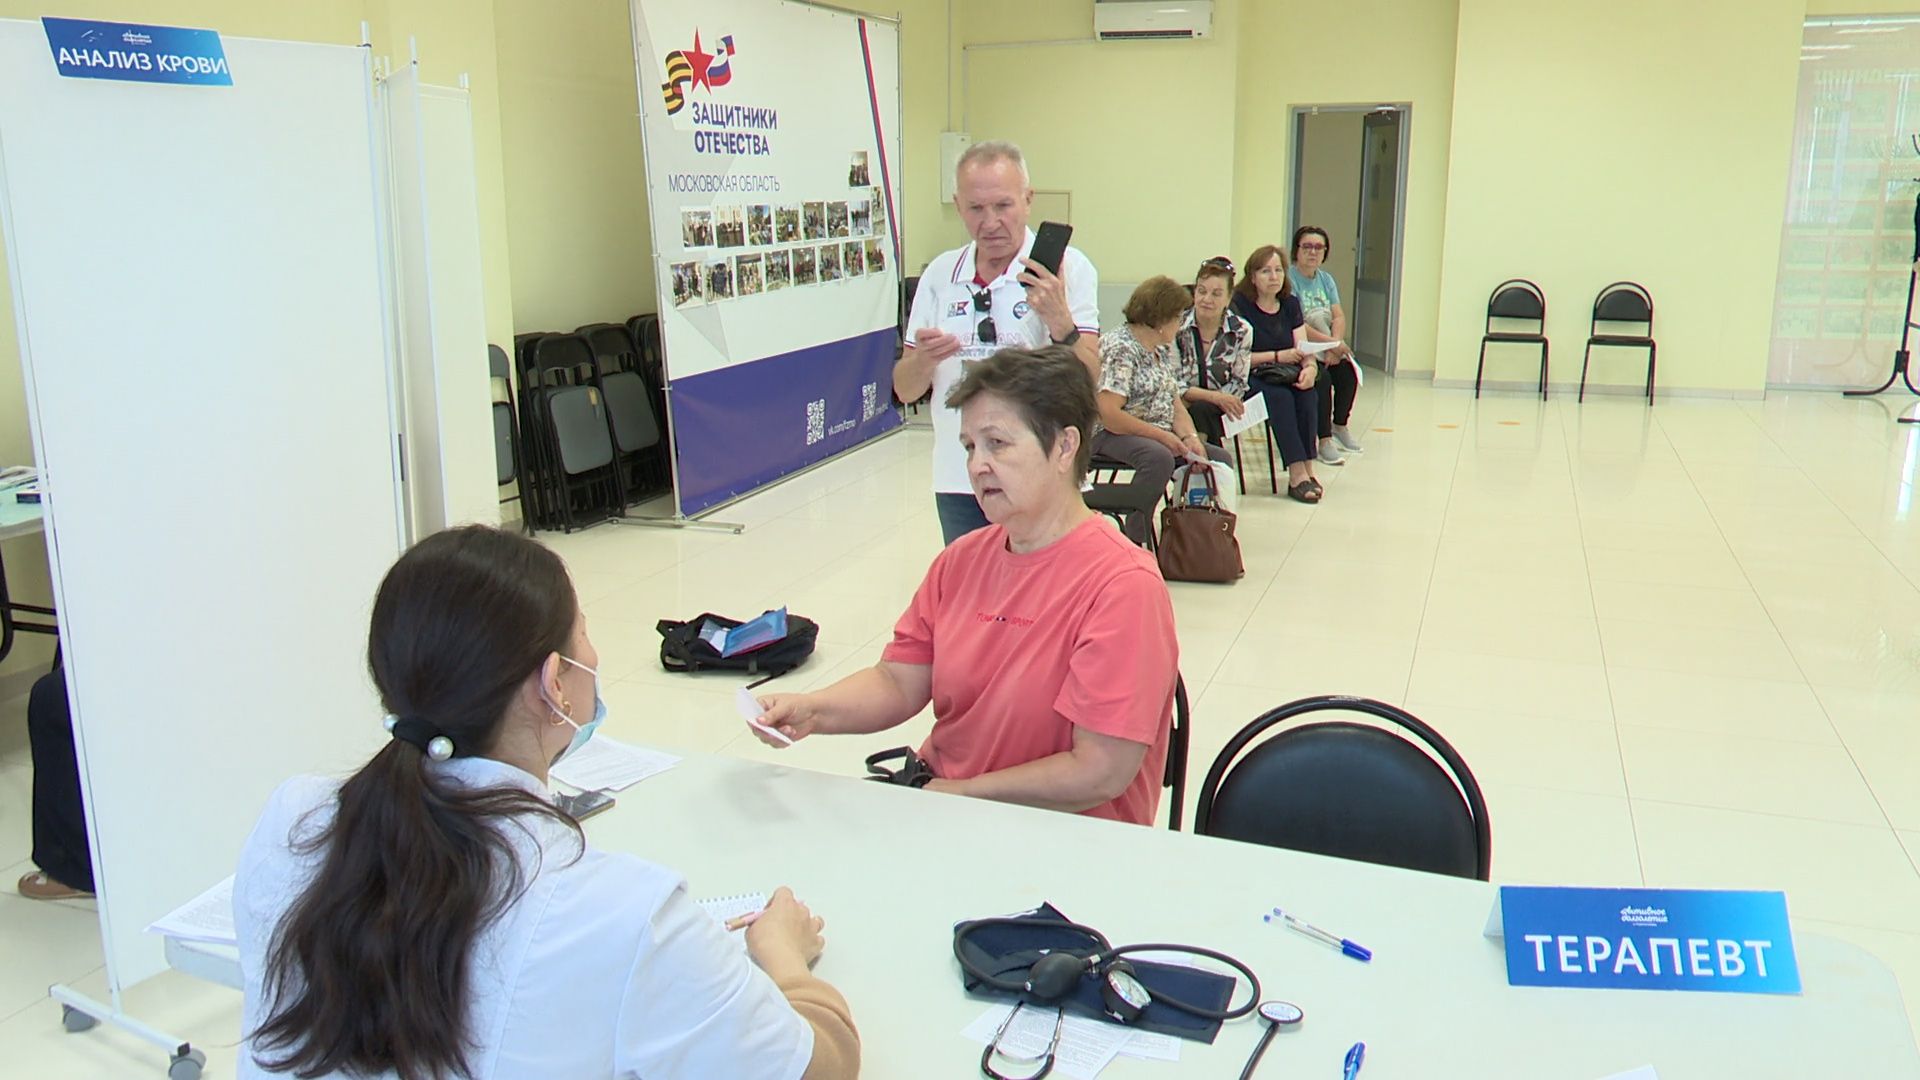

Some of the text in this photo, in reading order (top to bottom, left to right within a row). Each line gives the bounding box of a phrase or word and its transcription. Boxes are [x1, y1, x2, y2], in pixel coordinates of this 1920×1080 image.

[59, 47, 228, 75] АНАЛИЗ КРОВИ
[692, 102, 777, 130] ЗАЩИТНИКИ
[694, 131, 770, 156] ОТЕЧЕСТВА
[668, 174, 780, 192] МОСКОВСКАЯ ОБЛАСТЬ
[1524, 934, 1772, 977] ТЕРАПЕВТ
